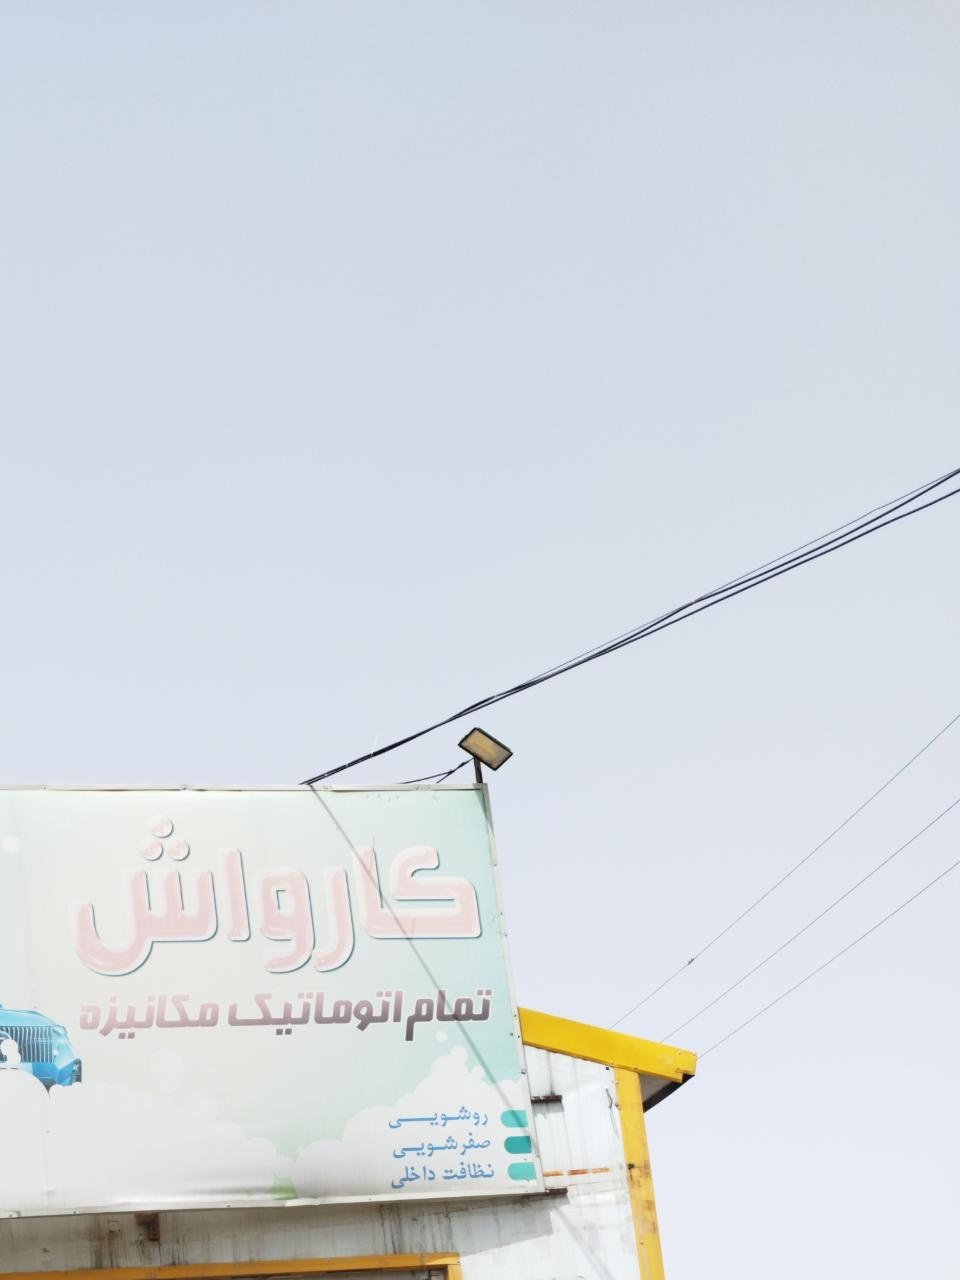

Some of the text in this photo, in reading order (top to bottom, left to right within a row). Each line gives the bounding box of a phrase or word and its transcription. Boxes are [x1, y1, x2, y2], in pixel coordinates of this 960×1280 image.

[72, 814, 484, 977] کارواش
[78, 988, 493, 1042] تمام اتوماتیک مکانیزه
[388, 1106, 488, 1128] روشویی
[391, 1162, 495, 1189] نظافت داخلی
